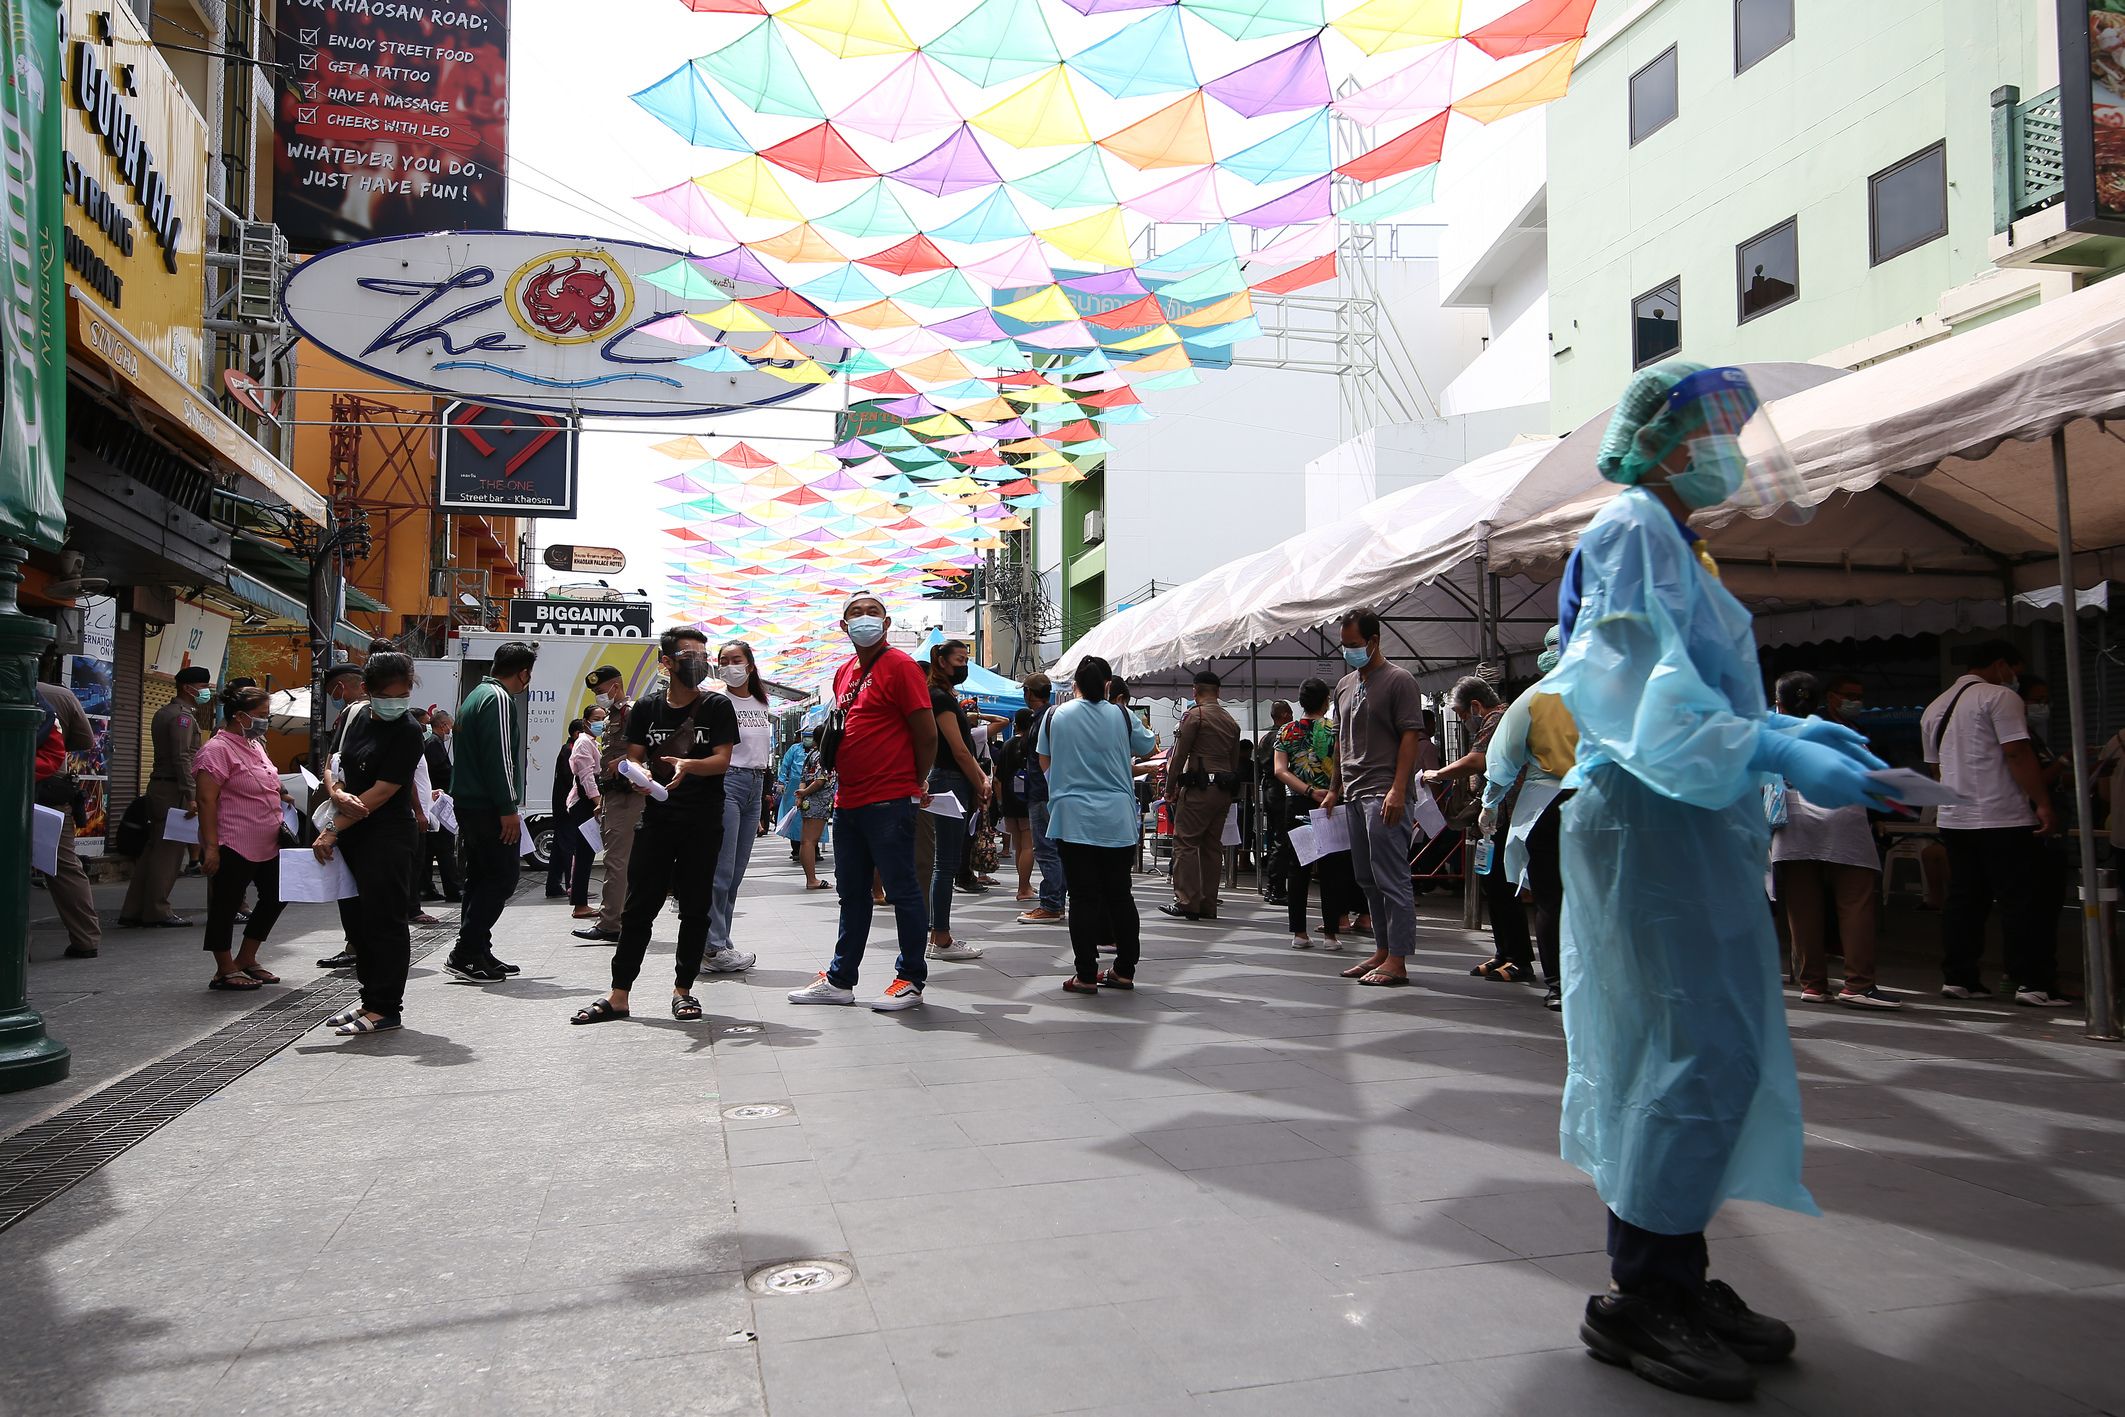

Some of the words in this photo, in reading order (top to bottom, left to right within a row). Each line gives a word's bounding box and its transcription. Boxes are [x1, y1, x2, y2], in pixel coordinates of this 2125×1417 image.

[332, 0, 424, 21] KHAOSAN
[328, 34, 374, 51] ENJOY
[379, 41, 433, 59] STREET
[436, 48, 474, 63] FOOD
[328, 61, 356, 74] GET
[359, 63, 369, 77] A
[373, 65, 431, 83] TATTOO
[328, 88, 365, 102] HAVE
[369, 91, 379, 106] A
[384, 94, 449, 113] MASSAGE
[327, 114, 380, 131] CHEERS
[384, 120, 418, 135] WITH
[422, 125, 450, 138] LEO
[75, 41, 183, 275] COCKTAIL
[287, 143, 395, 171] WHATEVER
[401, 155, 441, 175] YOU
[448, 162, 483, 180] DO,
[302, 170, 353, 190] JUST
[360, 176, 412, 195] HAVE
[420, 182, 468, 202] FUN!
[63, 151, 134, 258] STRONG
[40, 225, 55, 367] MINERAL
[357, 265, 527, 358] The
[89, 320, 139, 382] SINGHA
[182, 398, 218, 442] SINGHA
[251, 455, 277, 486] SINGHA
[460, 493, 487, 502] Street
[489, 493, 504, 503] bar
[514, 495, 552, 505] Khaosan
[480, 480, 504, 491] THE
[508, 480, 535, 492] ONE
[536, 605, 625, 622] BIGGAINK
[188, 627, 204, 650] 127
